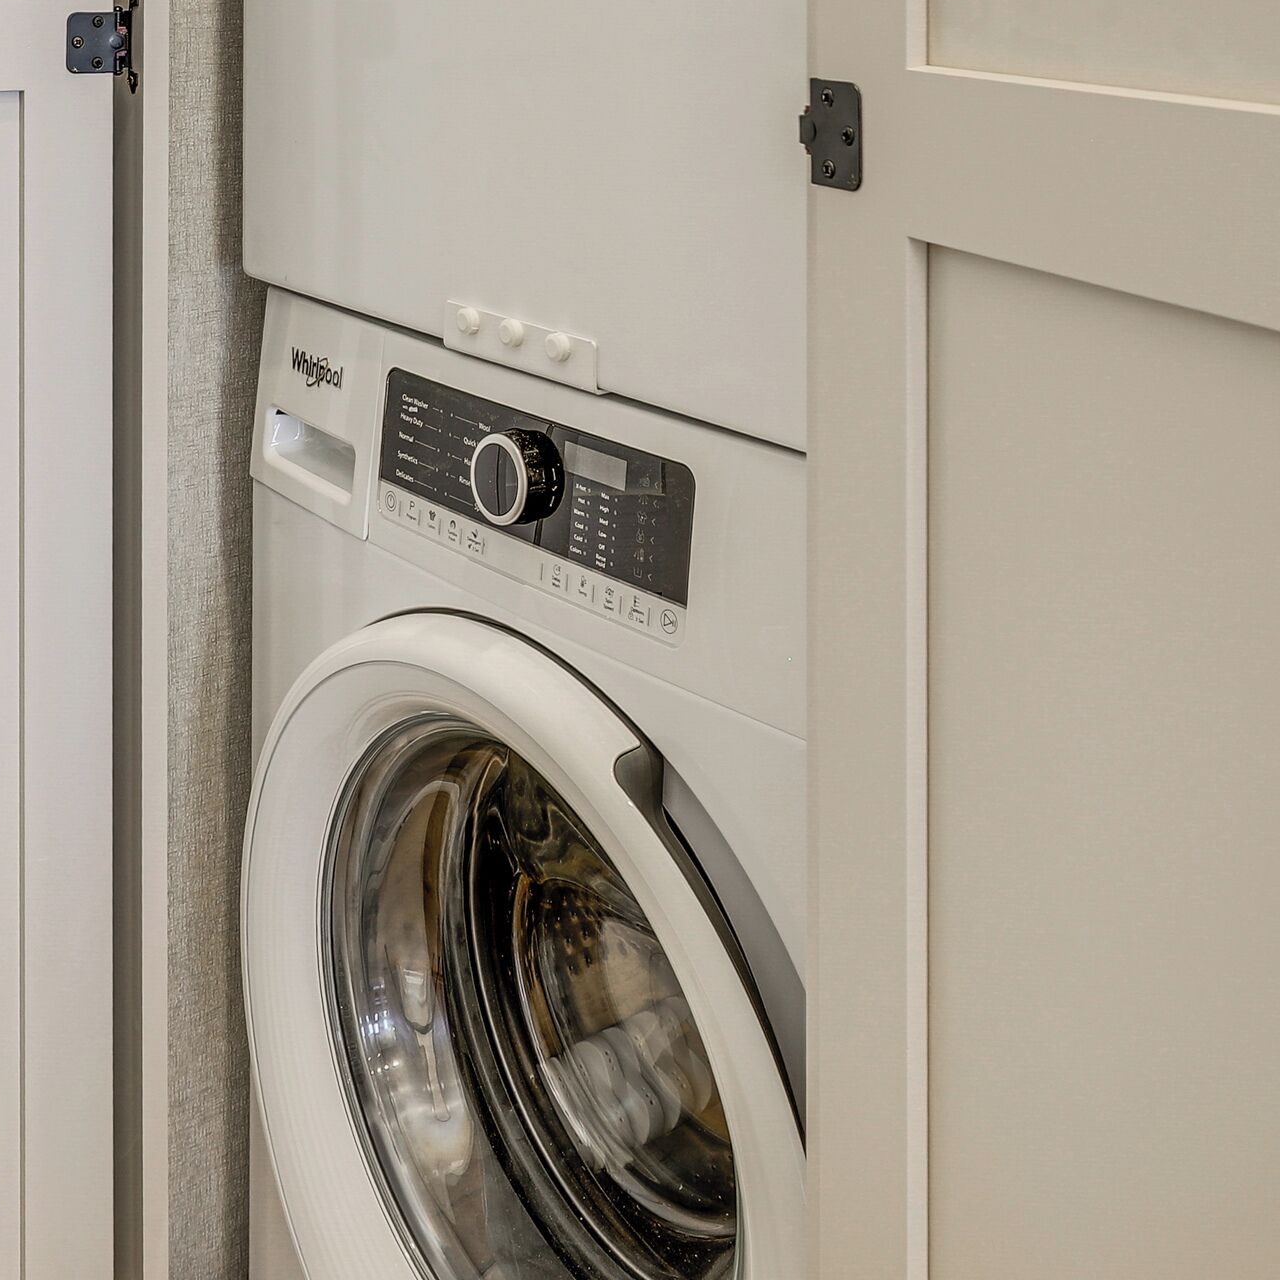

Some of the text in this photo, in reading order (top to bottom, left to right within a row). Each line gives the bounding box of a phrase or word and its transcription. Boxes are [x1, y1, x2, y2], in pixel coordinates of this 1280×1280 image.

[292, 347, 343, 390] Whirlpool
[402, 394, 414, 404] Clean
[401, 412, 424, 428] Heavy Duty
[478, 422, 491, 432] Wool
[399, 431, 415, 443] Normal
[463, 437, 477, 447] Quick
[397, 450, 418, 465] Synthetics
[396, 469, 414, 483] Delicates
